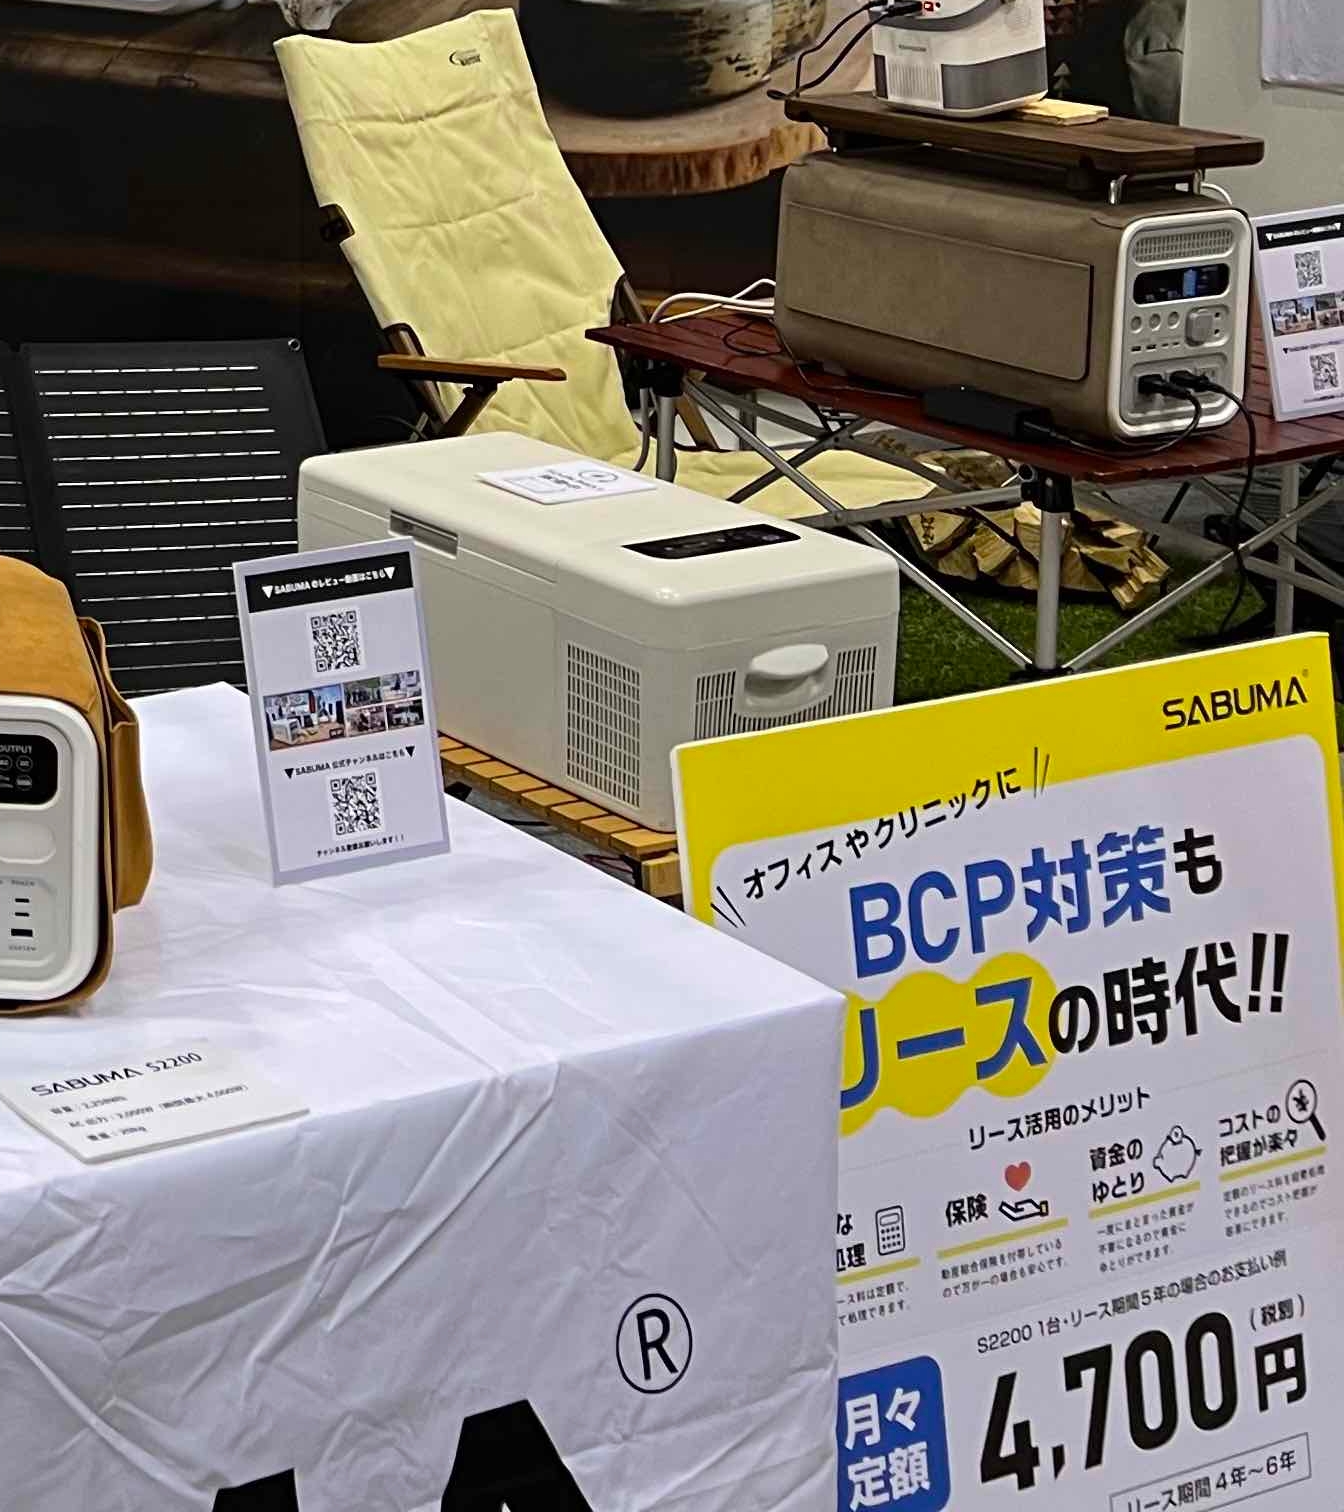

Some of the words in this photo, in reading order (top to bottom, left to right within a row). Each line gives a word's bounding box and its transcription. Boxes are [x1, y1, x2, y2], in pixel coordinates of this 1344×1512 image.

[1161, 675, 1309, 731] SABUMA
[743, 766, 1023, 902] オフィスやクリニックに
[849, 824, 1224, 980] BCP対策も
[31, 1067, 144, 1097] SABUMA
[145, 1052, 202, 1073] S2200
[968, 1086, 1151, 1152] リース活用のメリット
[1218, 1103, 1281, 1138] コストの
[1089, 1138, 1145, 1171] 資金の
[945, 1193, 989, 1228] 保険
[1091, 1171, 1146, 1204] ゆとり
[844, 1386, 921, 1451] 月々
[847, 1440, 932, 1511] 定額
